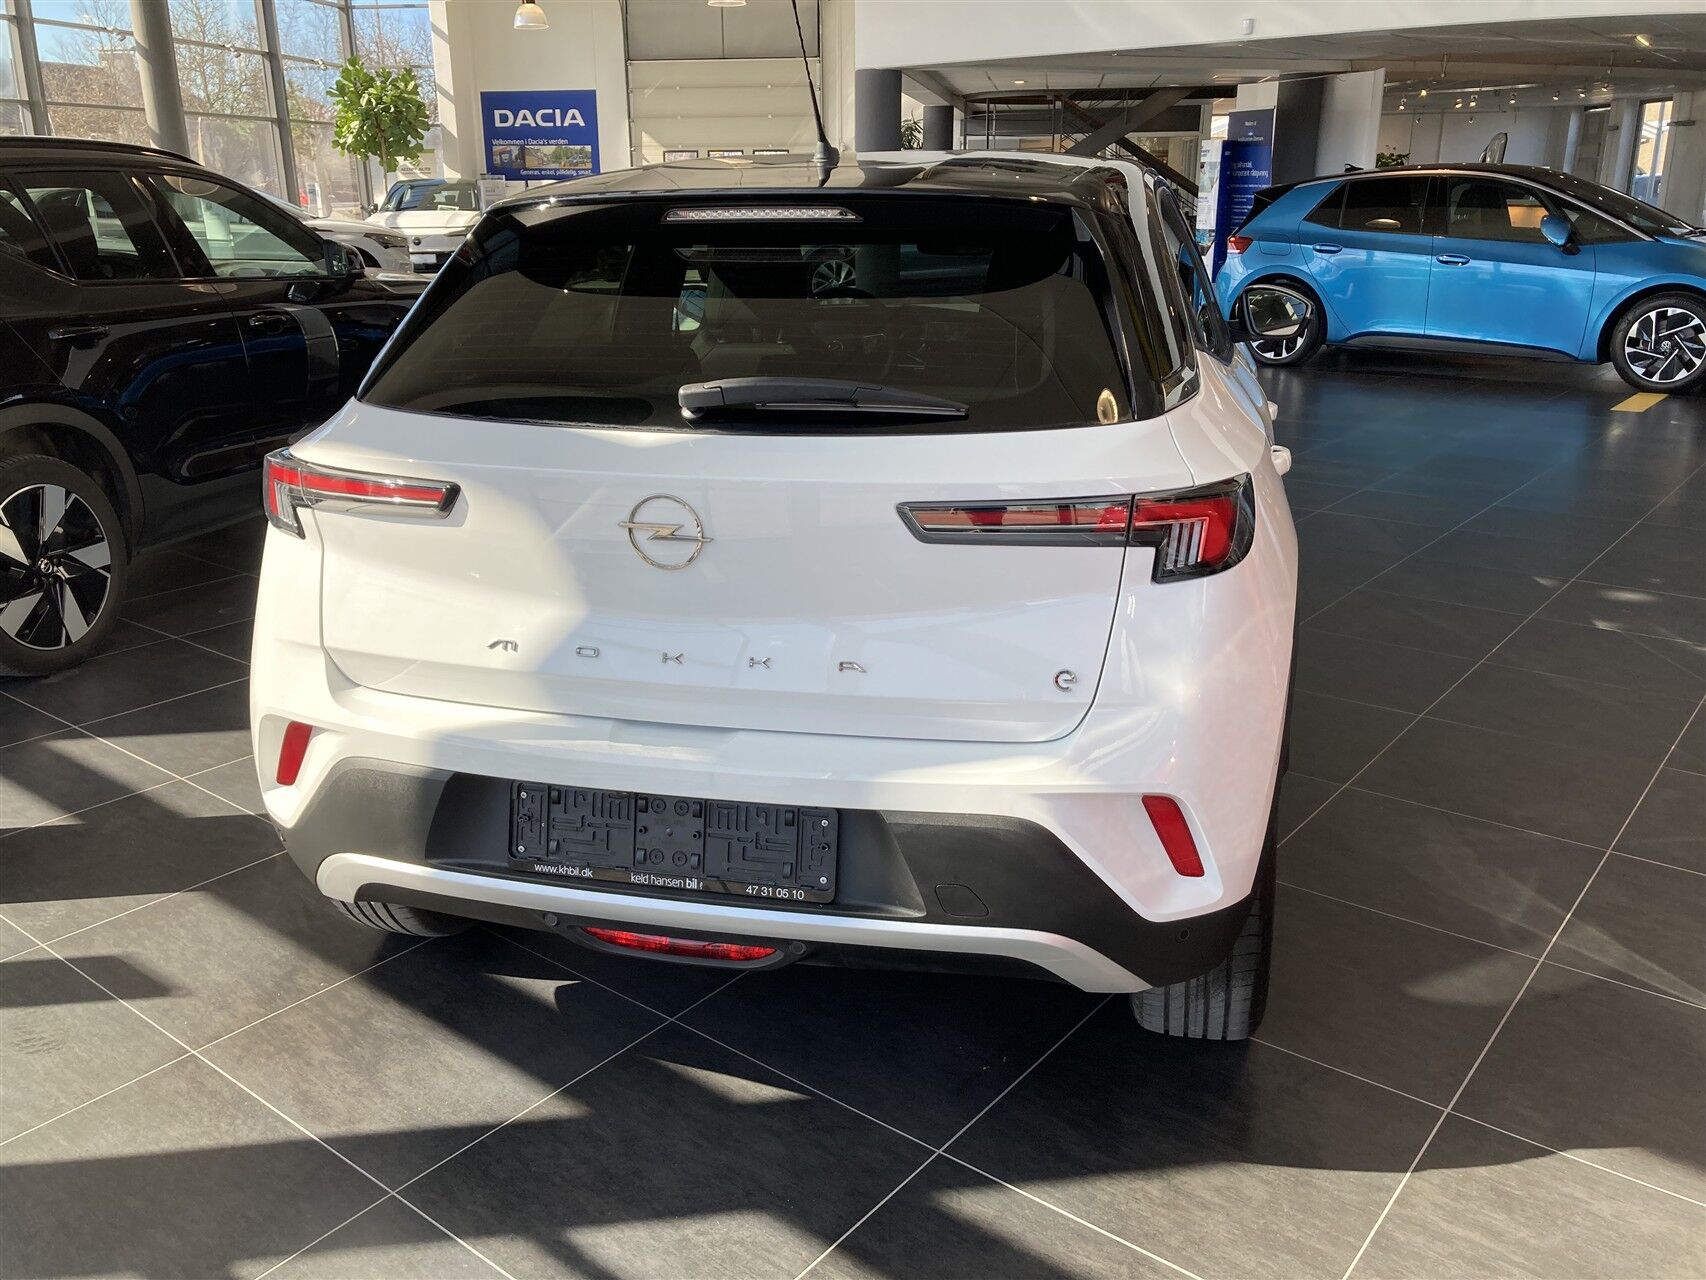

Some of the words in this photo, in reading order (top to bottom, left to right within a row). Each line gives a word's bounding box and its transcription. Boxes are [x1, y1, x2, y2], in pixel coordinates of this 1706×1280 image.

[493, 108, 586, 128] DACIA
[534, 864, 593, 878] www.khbil.dk
[630, 872, 649, 885] keld
[650, 874, 684, 888] hansen
[746, 885, 758, 895] 47
[760, 886, 773, 897] 31
[775, 887, 789, 899] 05
[792, 889, 805, 901] 10
